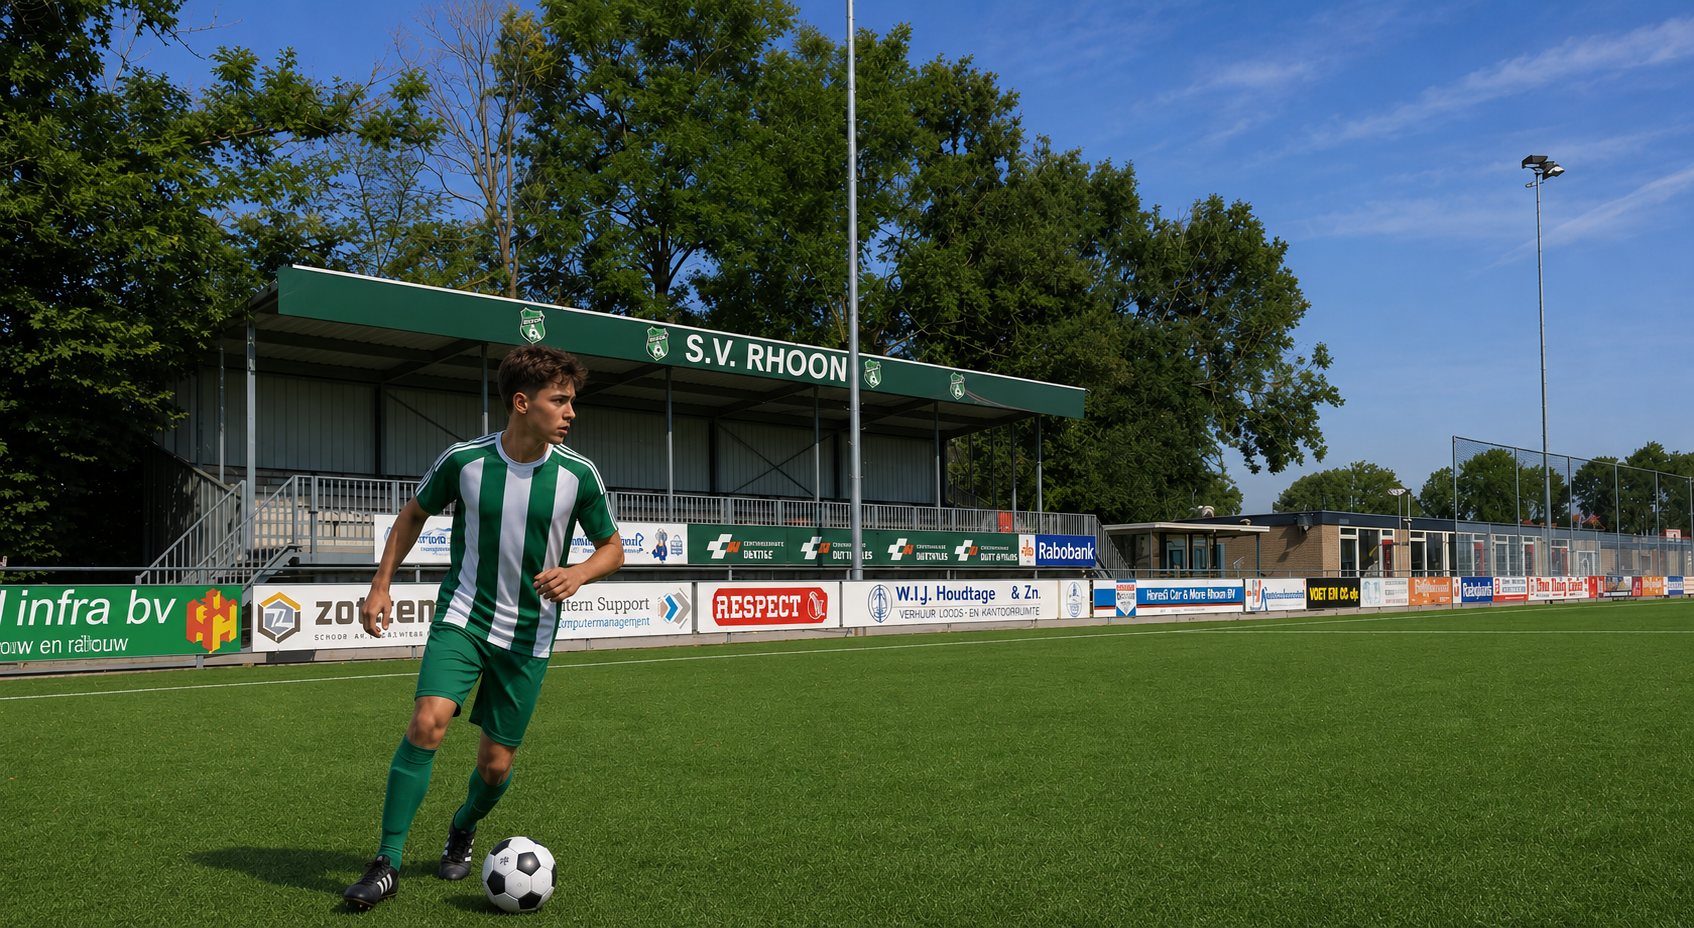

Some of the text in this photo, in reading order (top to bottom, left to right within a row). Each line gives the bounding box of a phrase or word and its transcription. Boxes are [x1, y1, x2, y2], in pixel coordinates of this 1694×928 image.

[685, 334, 848, 382] S.V. RHOON
[1039, 542, 1094, 560] Rabobank
[936, 586, 996, 604] Houdtage
[1011, 585, 1020, 600] &
[1024, 585, 1042, 600] Zn.
[1310, 586, 1327, 601] VOET
[17, 589, 110, 625] infra
[126, 589, 176, 624] bv
[597, 597, 650, 614] Support
[716, 595, 801, 619] RESPECT
[899, 608, 936, 619] VERHUUR
[969, 608, 979, 617] EN
[40, 639, 62, 654] en
